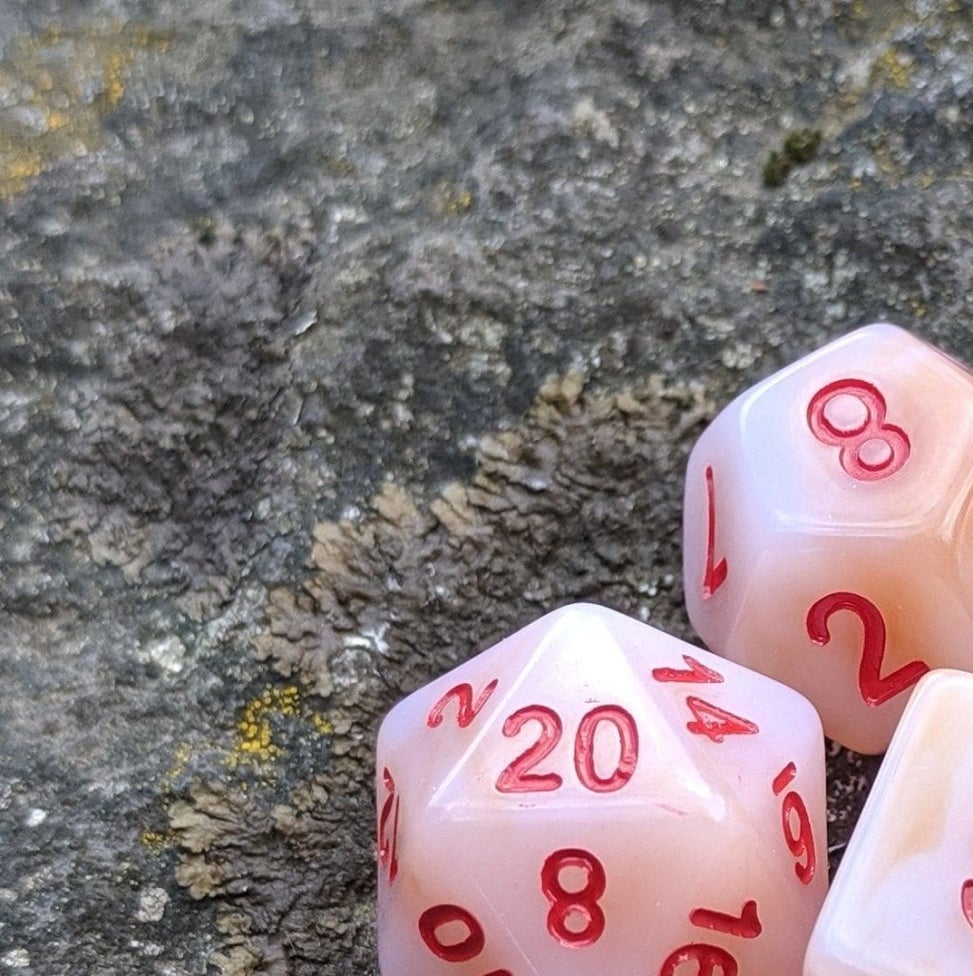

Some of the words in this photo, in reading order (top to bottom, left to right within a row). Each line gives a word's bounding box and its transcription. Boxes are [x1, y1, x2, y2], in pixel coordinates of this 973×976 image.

[806, 379, 911, 481] 8
[704, 466, 728, 599] 1
[652, 655, 759, 742] 14
[806, 591, 930, 707] 2
[427, 679, 499, 729] 2
[495, 704, 639, 794] 20
[540, 848, 607, 950] 8
